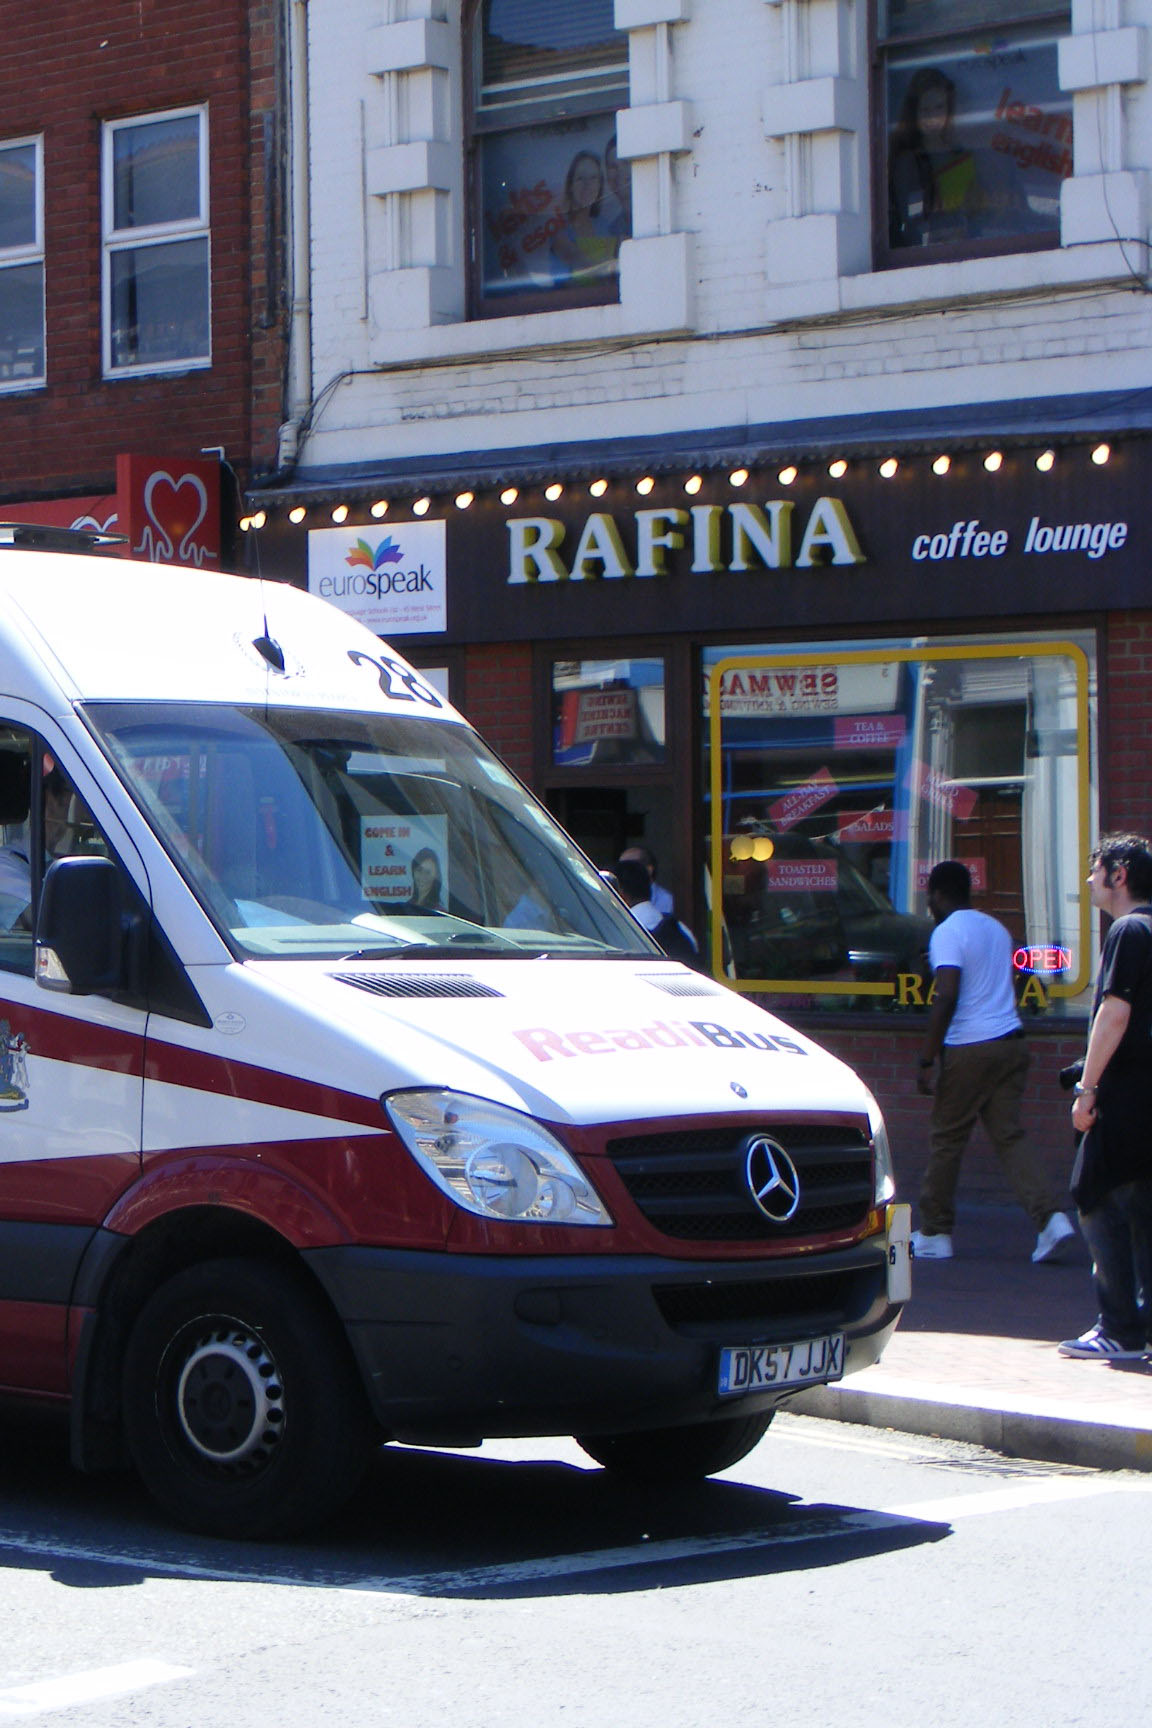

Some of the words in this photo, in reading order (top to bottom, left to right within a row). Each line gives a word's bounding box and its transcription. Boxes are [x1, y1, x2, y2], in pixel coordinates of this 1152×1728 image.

[506, 496, 866, 584] RAFINA
[912, 521, 1008, 560] coffee
[1023, 517, 1128, 559] lounge
[319, 563, 433, 600] eurospeak
[346, 649, 444, 709] 28
[854, 721, 873, 732] TEA
[848, 732, 889, 744] COFFEE
[364, 826, 397, 838] COME
[853, 822, 895, 832] SALADS
[384, 844, 395, 856] &
[368, 865, 407, 876] LEARN
[778, 865, 826, 875] TOASTED
[768, 876, 838, 887] SANDWICHES
[1013, 948, 1072, 969] OPEN
[511, 1020, 809, 1063] ReadiBus
[734, 1346, 794, 1386] DK57
[799, 1337, 841, 1378] JJX
